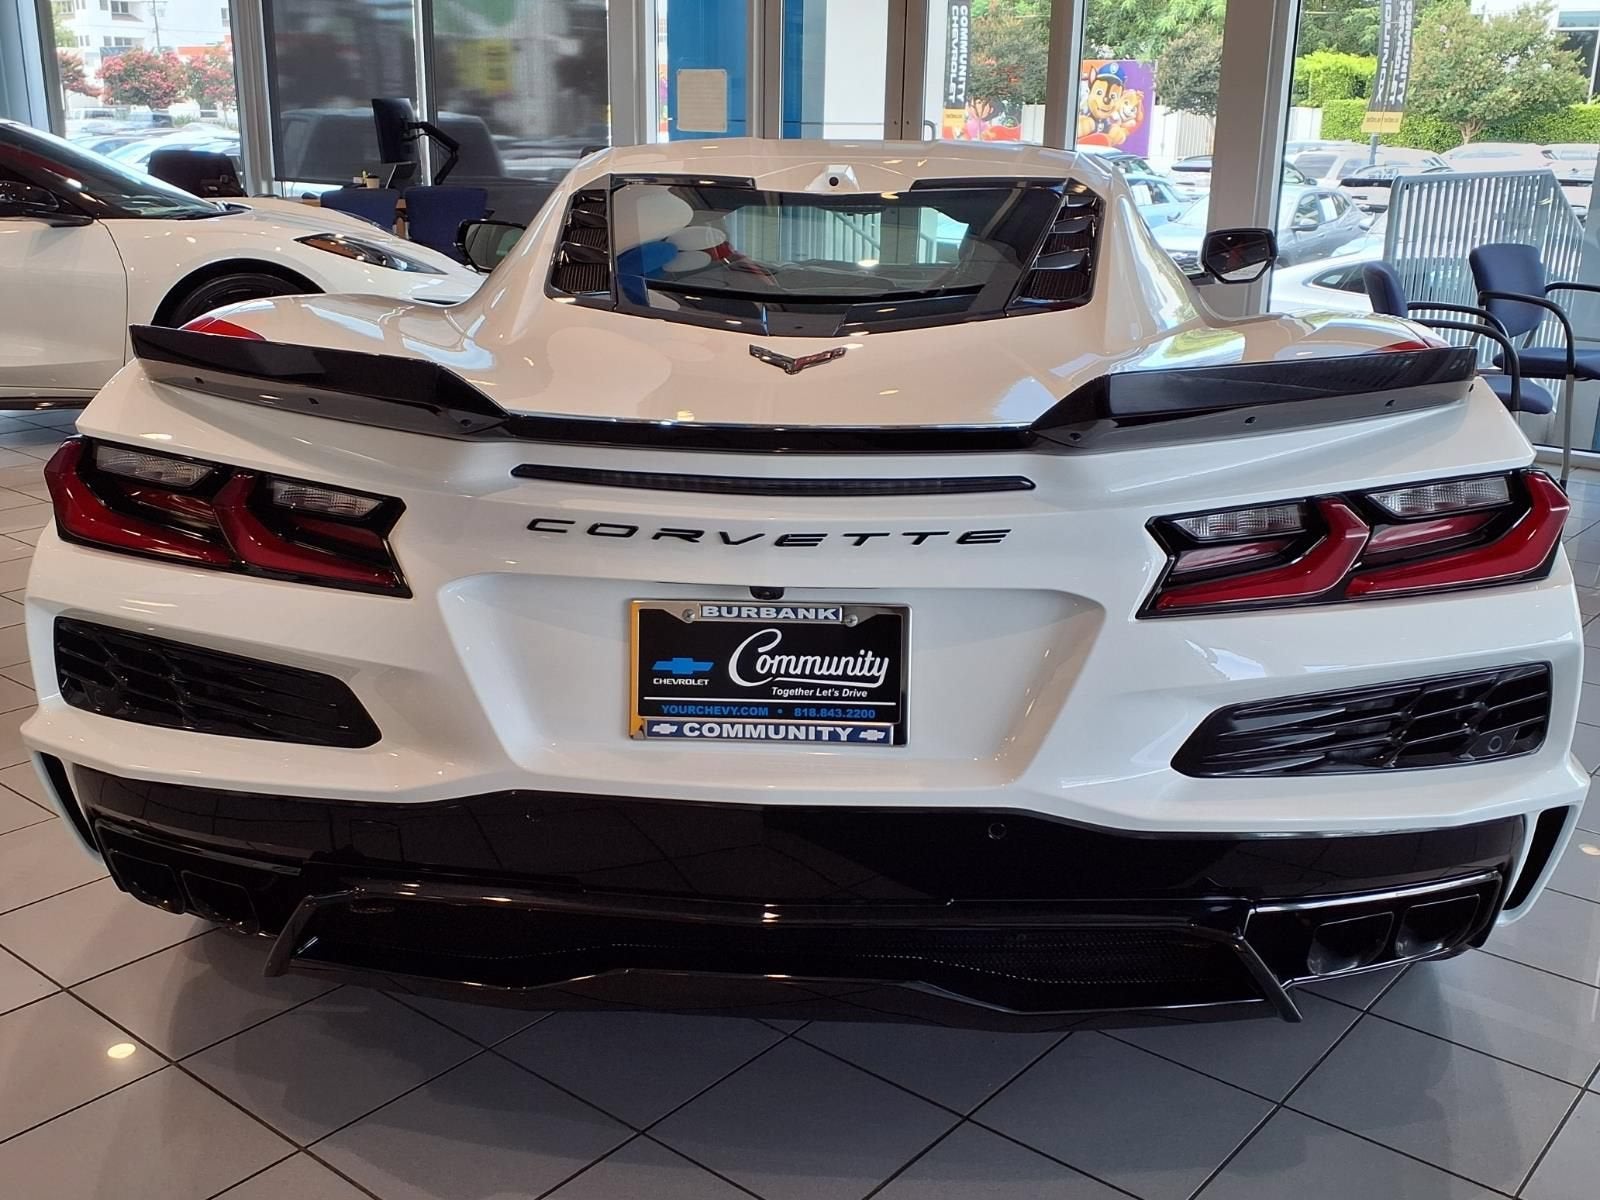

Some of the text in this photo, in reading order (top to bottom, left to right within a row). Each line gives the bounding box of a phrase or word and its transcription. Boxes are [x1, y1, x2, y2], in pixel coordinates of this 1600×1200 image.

[949, 5, 959, 103] CHEVROLET
[957, 5, 968, 102] COMMUNITY
[1375, 0, 1392, 103] QUINOX
[1389, 0, 1405, 105] HEVROLET
[1397, 0, 1413, 104] OMMUNITY
[526, 517, 1012, 547] CORVETTE
[701, 605, 837, 620] BURBANK
[728, 628, 889, 687] Community
[653, 677, 710, 686] CHEVROLET
[771, 686, 868, 698] Together Let's Drive
[661, 704, 876, 719] YOURCHEVY.COM 818.843.2200
[682, 722, 853, 741] COMMUNITY
